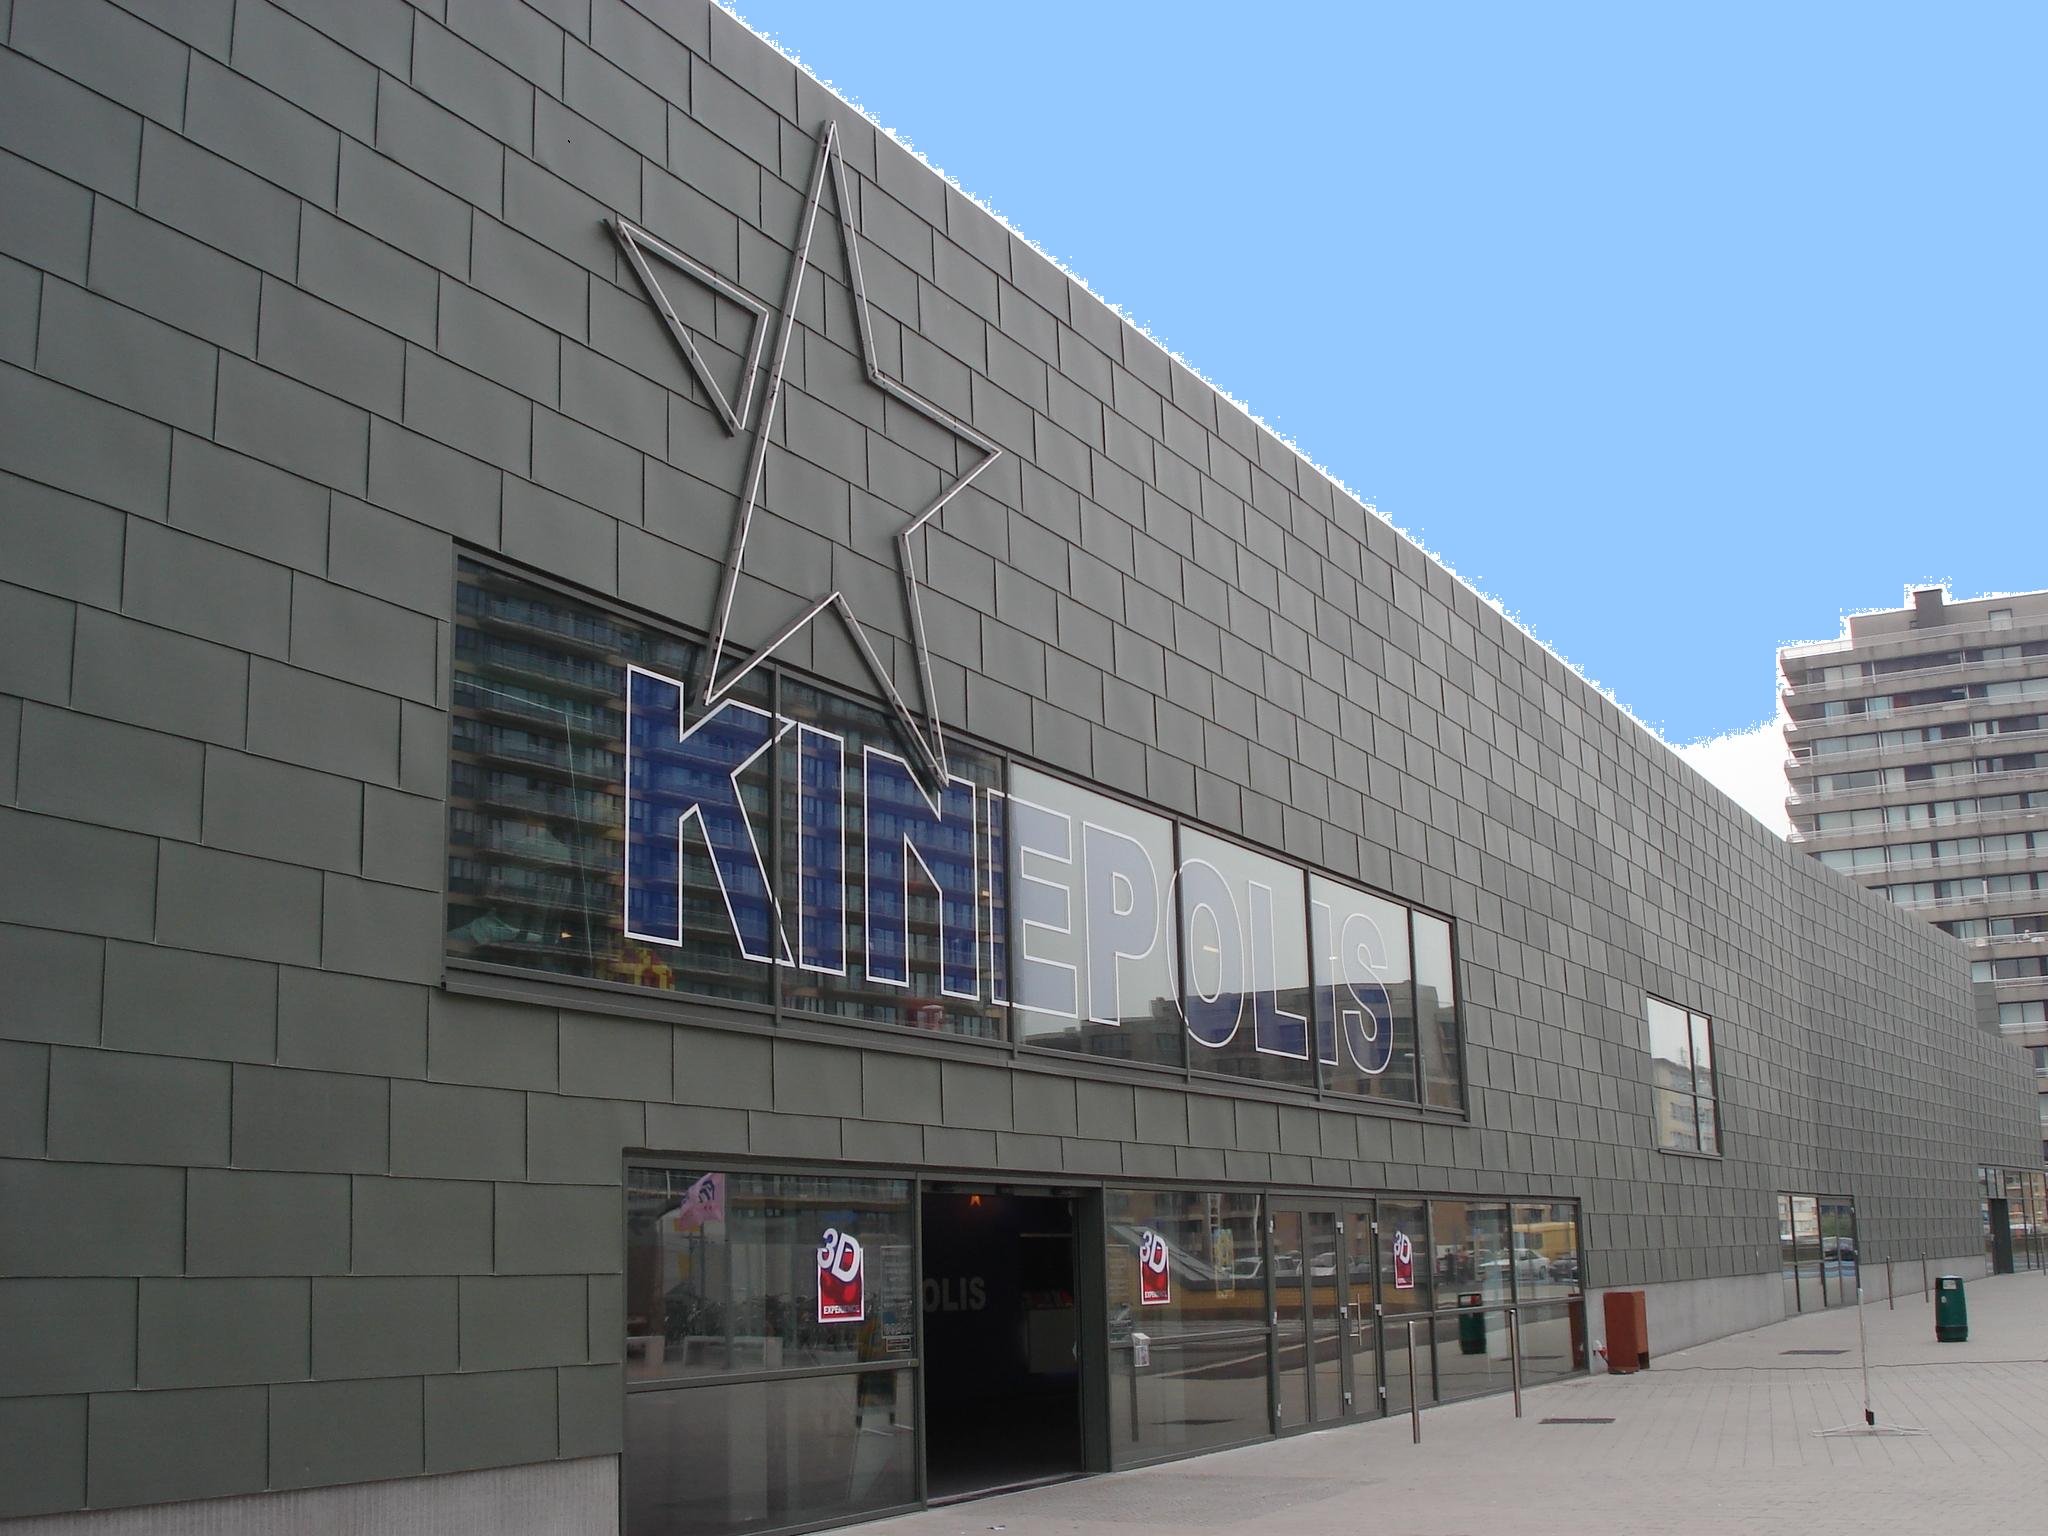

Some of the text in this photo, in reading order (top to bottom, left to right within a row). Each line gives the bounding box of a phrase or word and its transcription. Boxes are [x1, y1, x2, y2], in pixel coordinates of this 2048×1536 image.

[624, 664, 1394, 1075] KINEPOLIS
[817, 1228, 861, 1283] 3D
[1139, 1230, 1167, 1273] 3D
[1393, 1230, 1412, 1264] 3D
